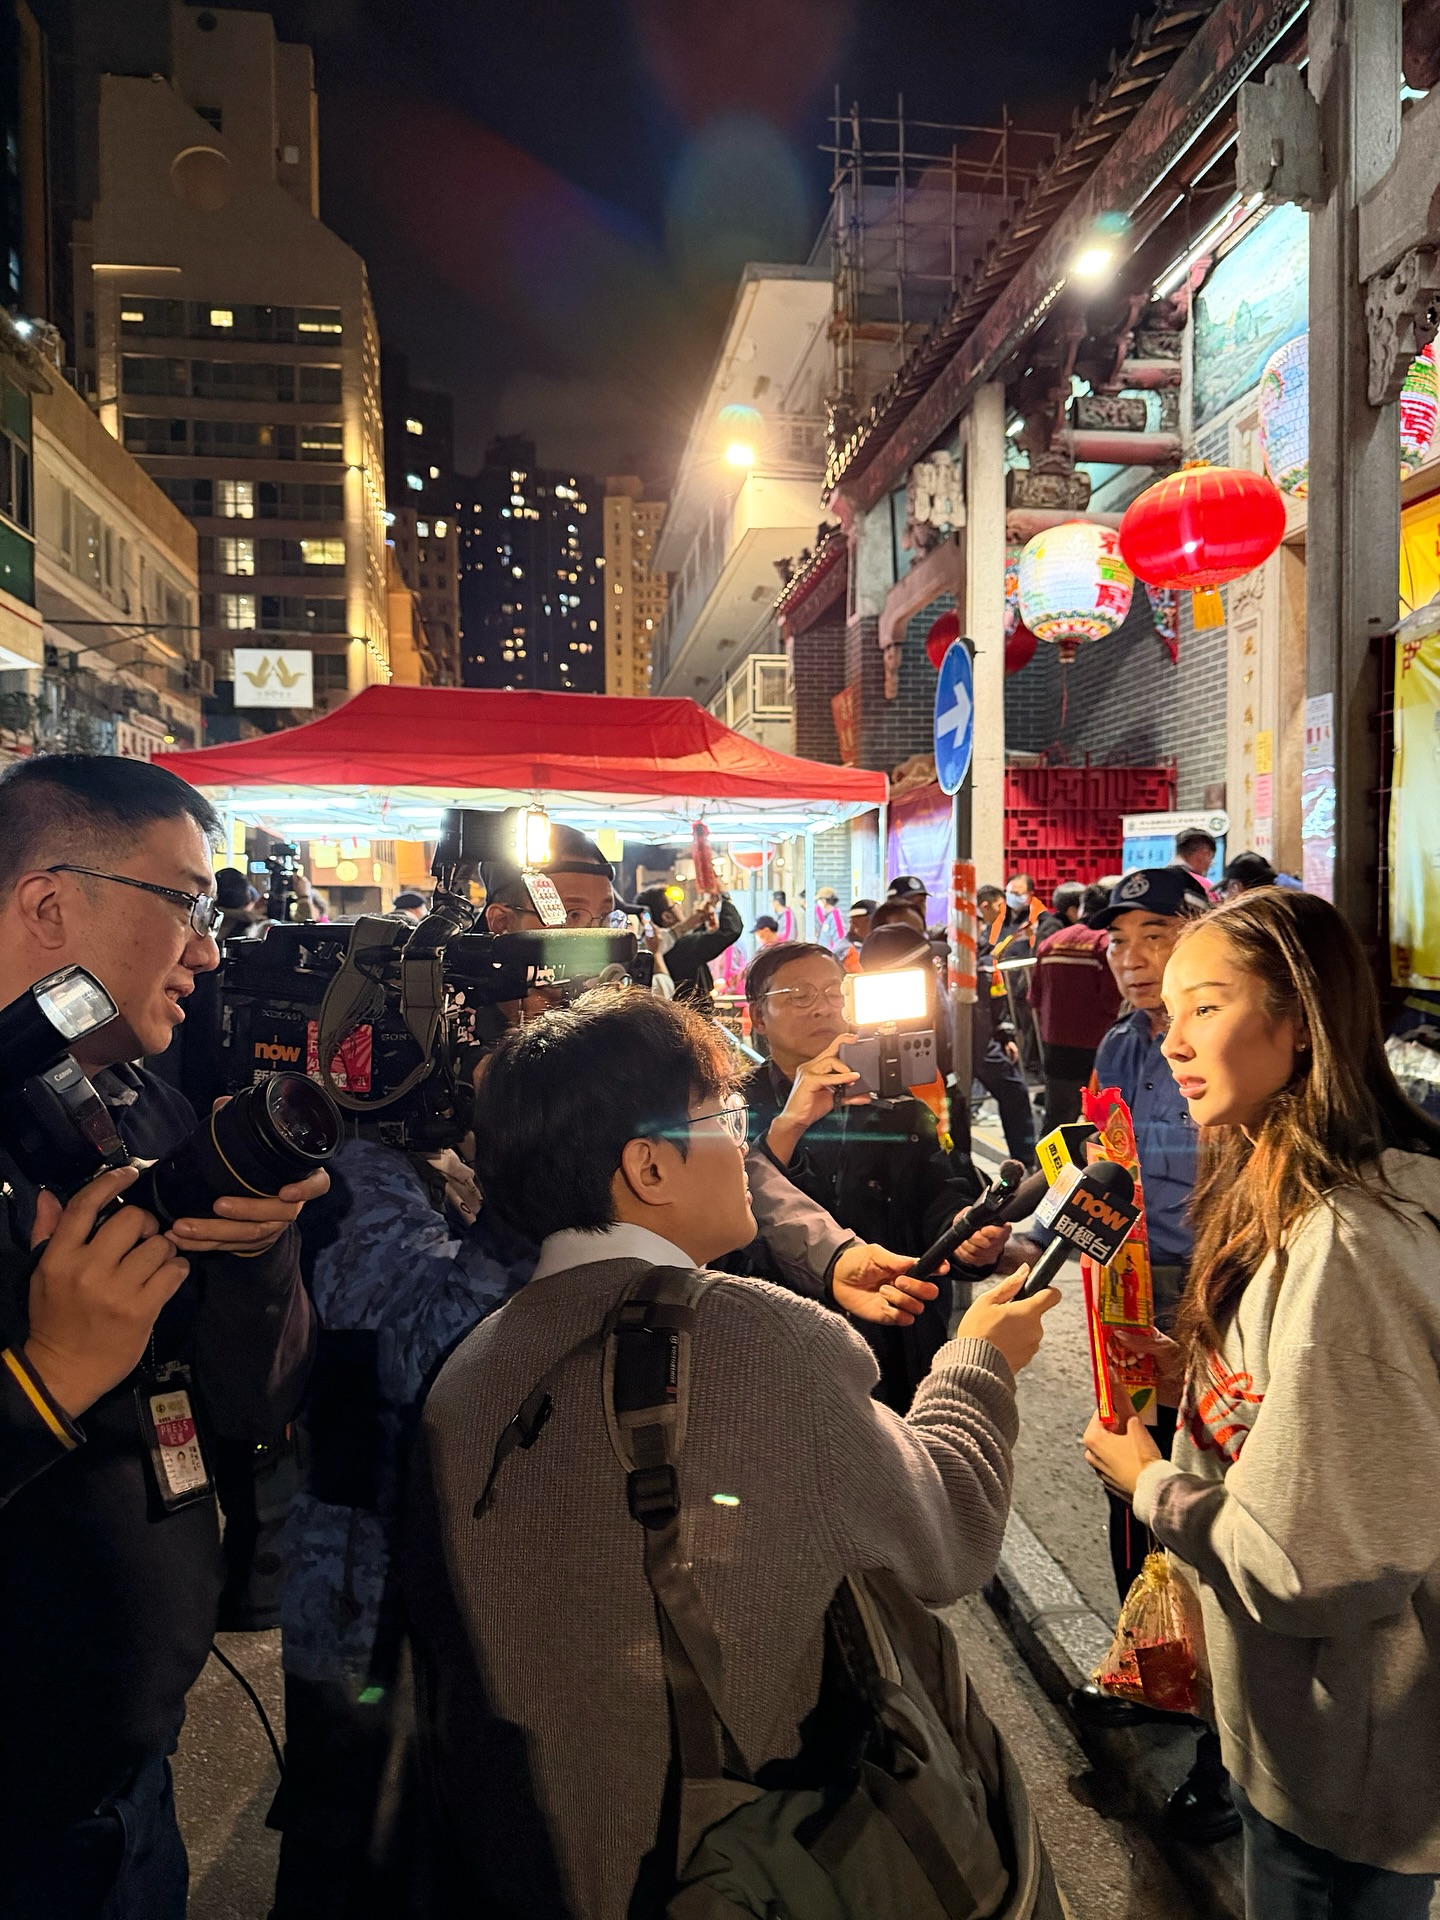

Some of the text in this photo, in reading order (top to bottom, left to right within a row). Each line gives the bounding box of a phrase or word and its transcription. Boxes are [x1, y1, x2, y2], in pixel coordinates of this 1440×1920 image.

[254, 1042, 301, 1062] now
[54, 1067, 73, 1082] Canon
[1072, 1188, 1130, 1231] now
[1054, 1213, 1112, 1260] 財經台
[160, 1420, 189, 1436] PRESS
